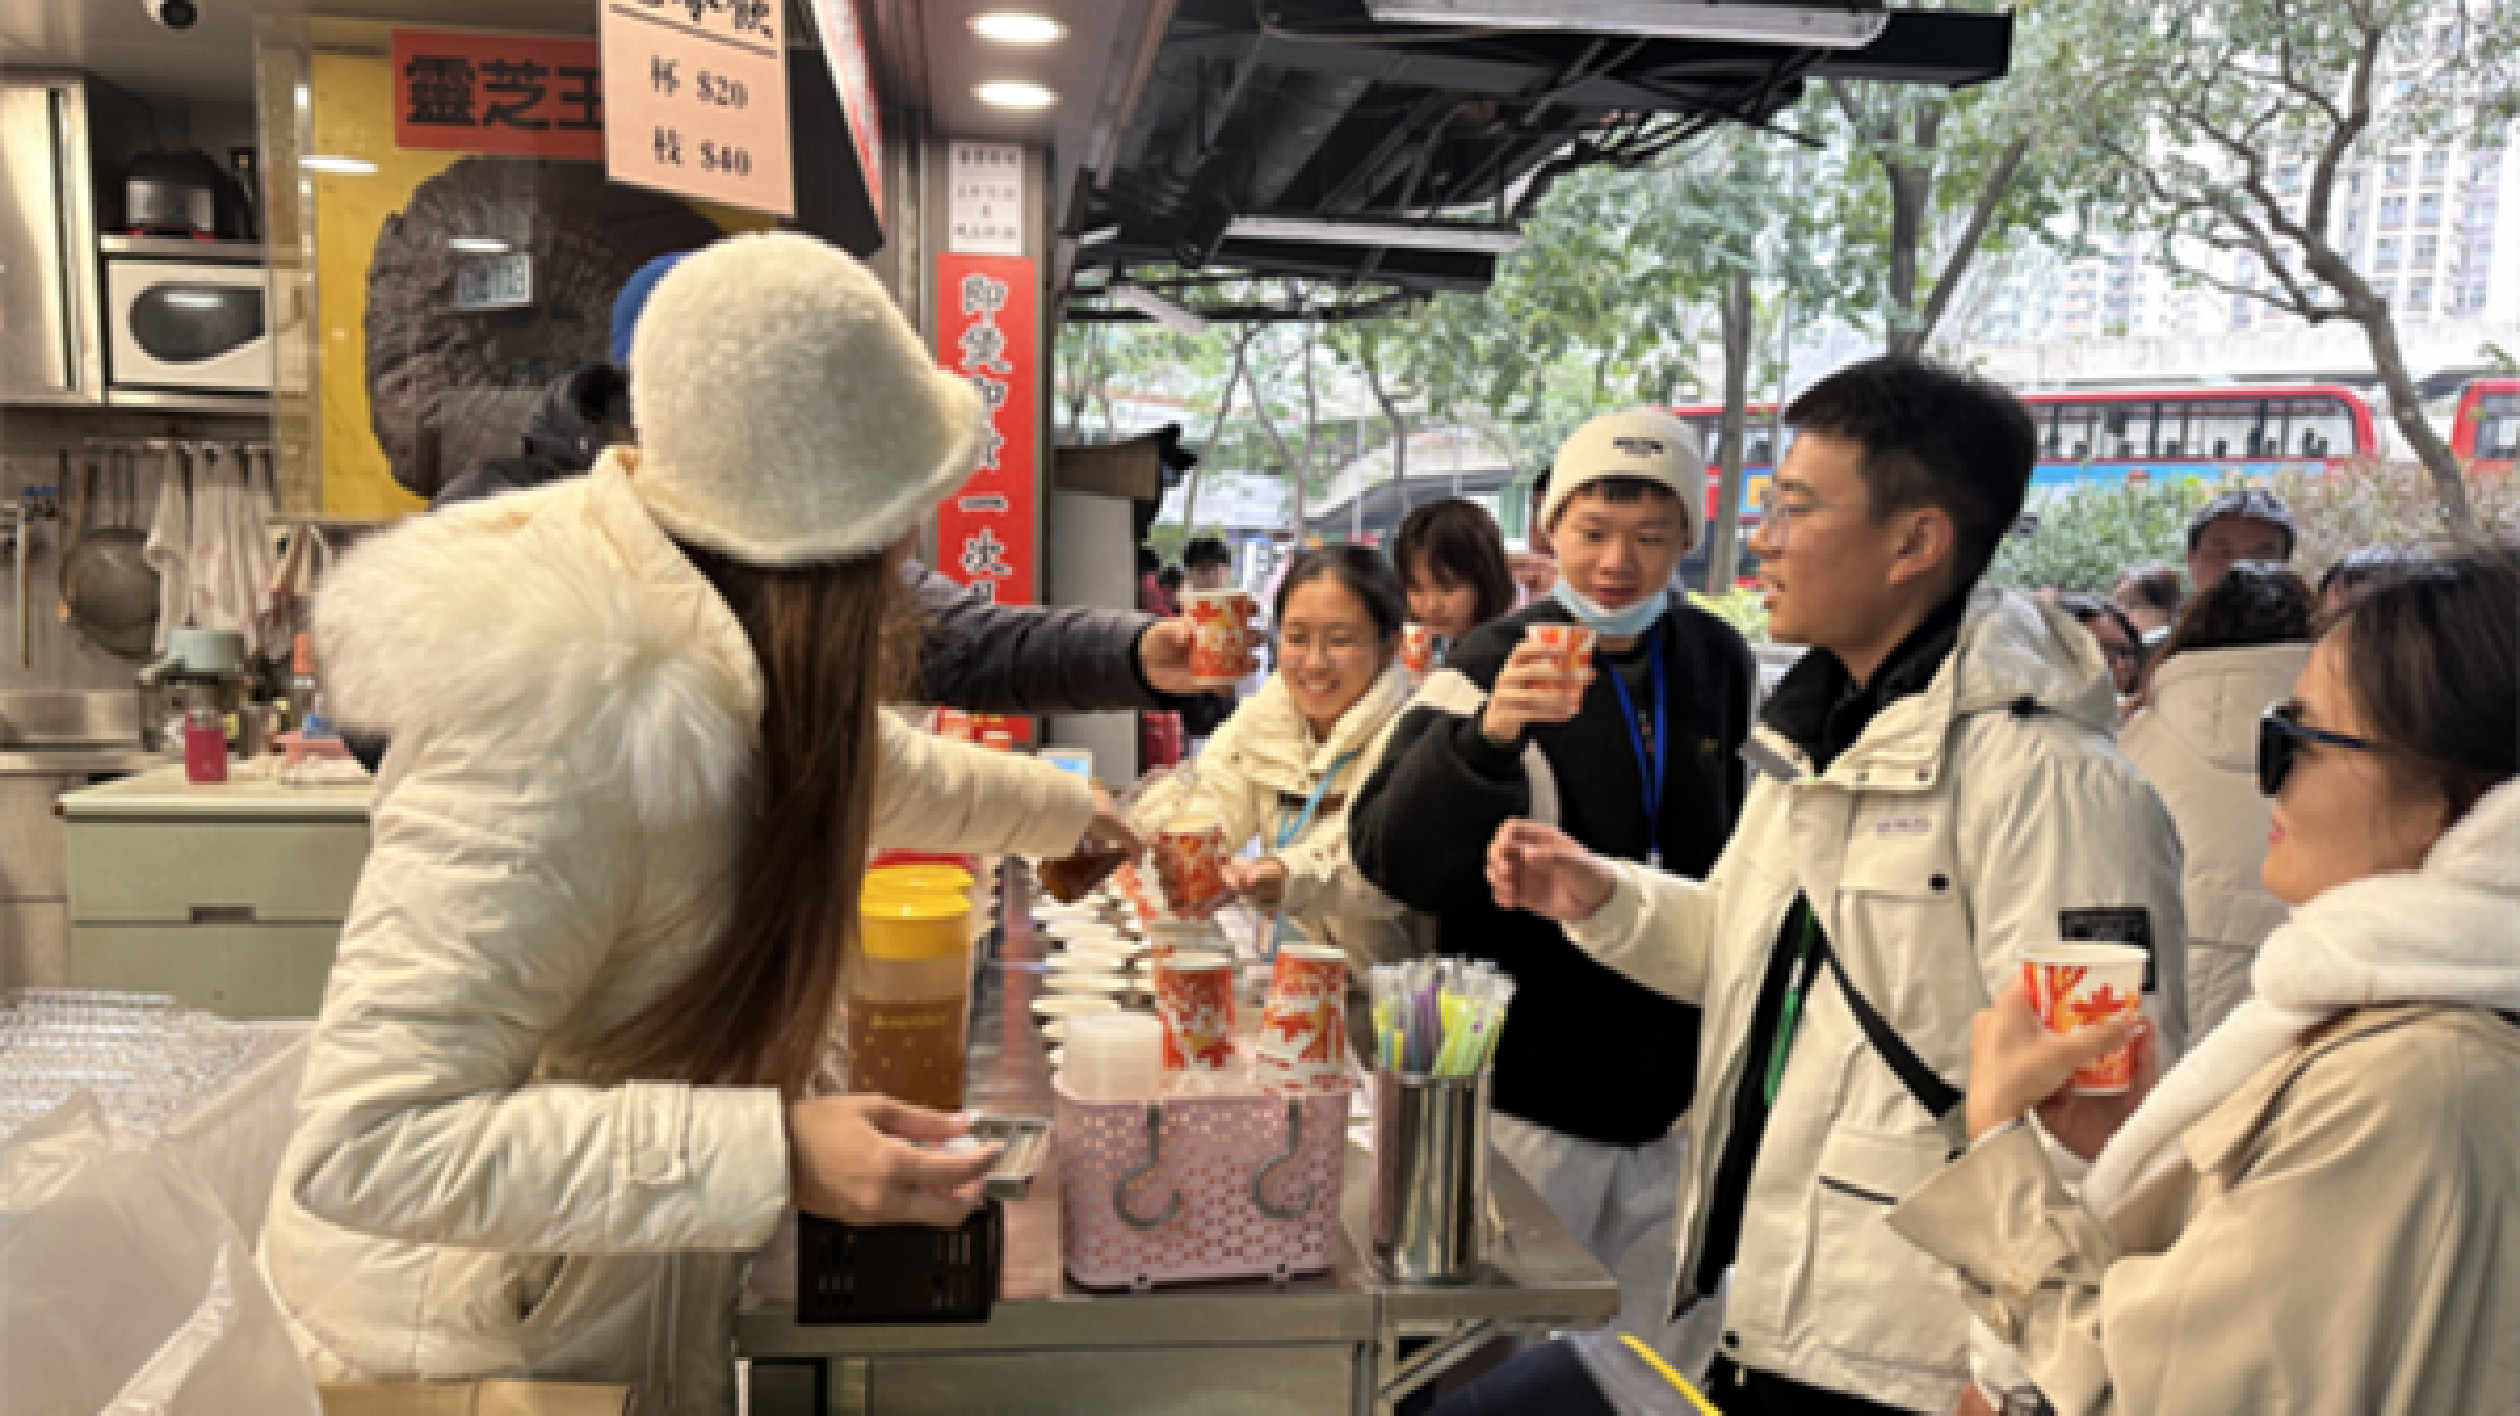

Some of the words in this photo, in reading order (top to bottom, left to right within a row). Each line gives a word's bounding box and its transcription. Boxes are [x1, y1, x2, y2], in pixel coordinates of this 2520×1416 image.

[403, 55, 605, 130] 靈芝王
[696, 69, 749, 110] $20
[700, 138, 752, 178] $40
